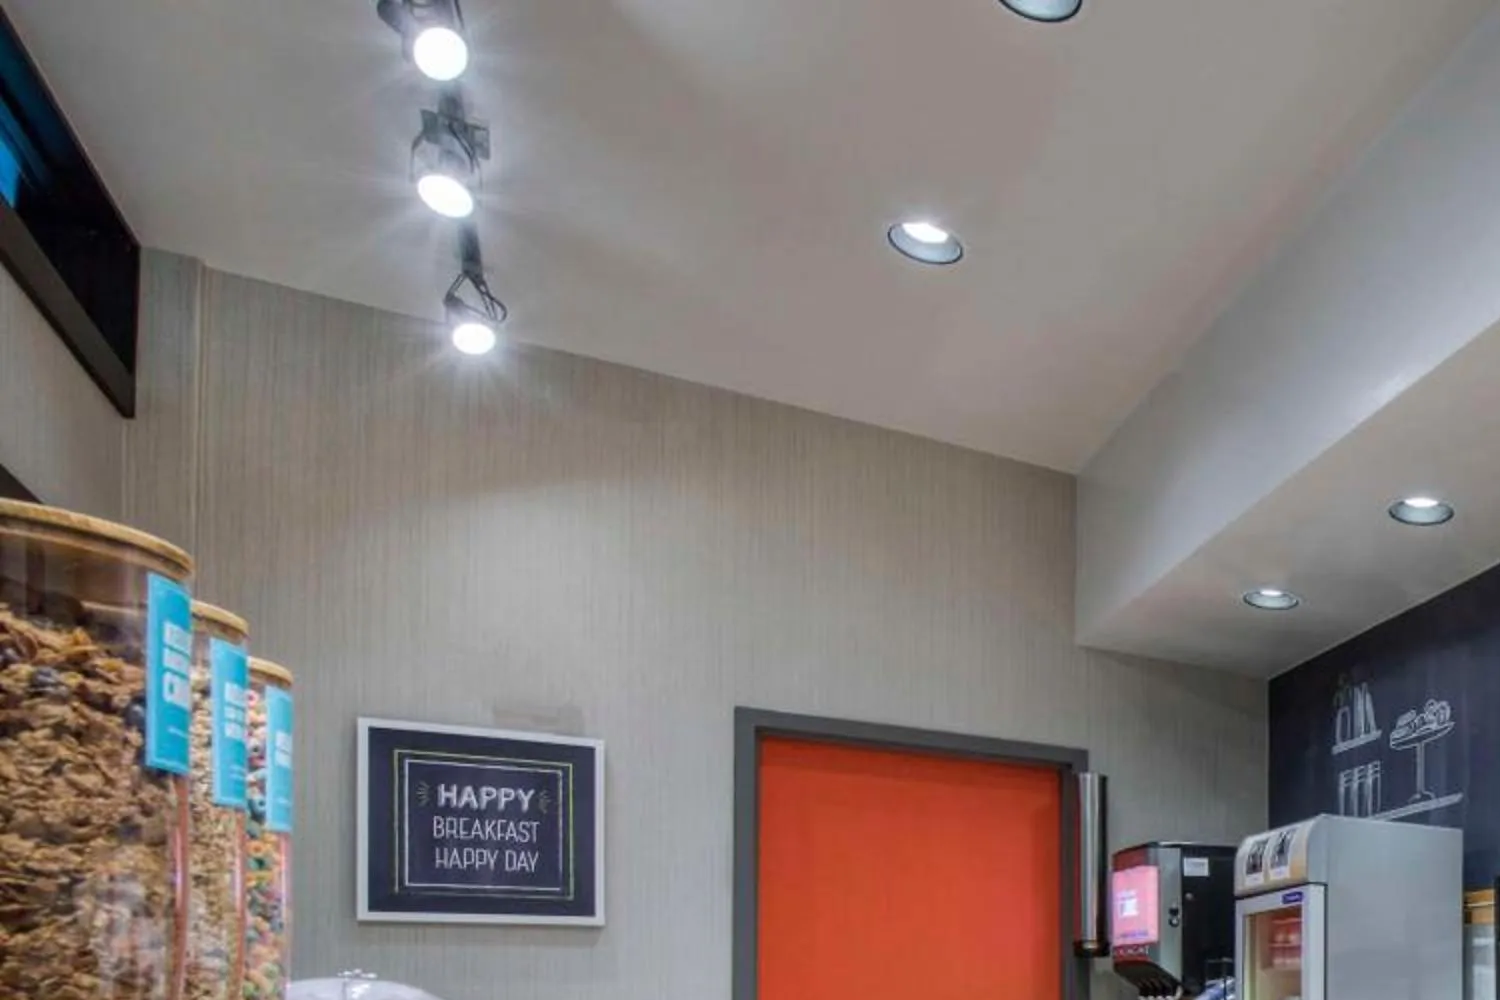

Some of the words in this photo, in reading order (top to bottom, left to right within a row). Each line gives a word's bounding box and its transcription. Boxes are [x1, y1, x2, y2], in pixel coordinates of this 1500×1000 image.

[437, 783, 535, 812] HAPPY
[432, 815, 540, 843] BREAKFAST
[434, 847, 498, 871] HAPPY
[504, 849, 539, 873] DAY
